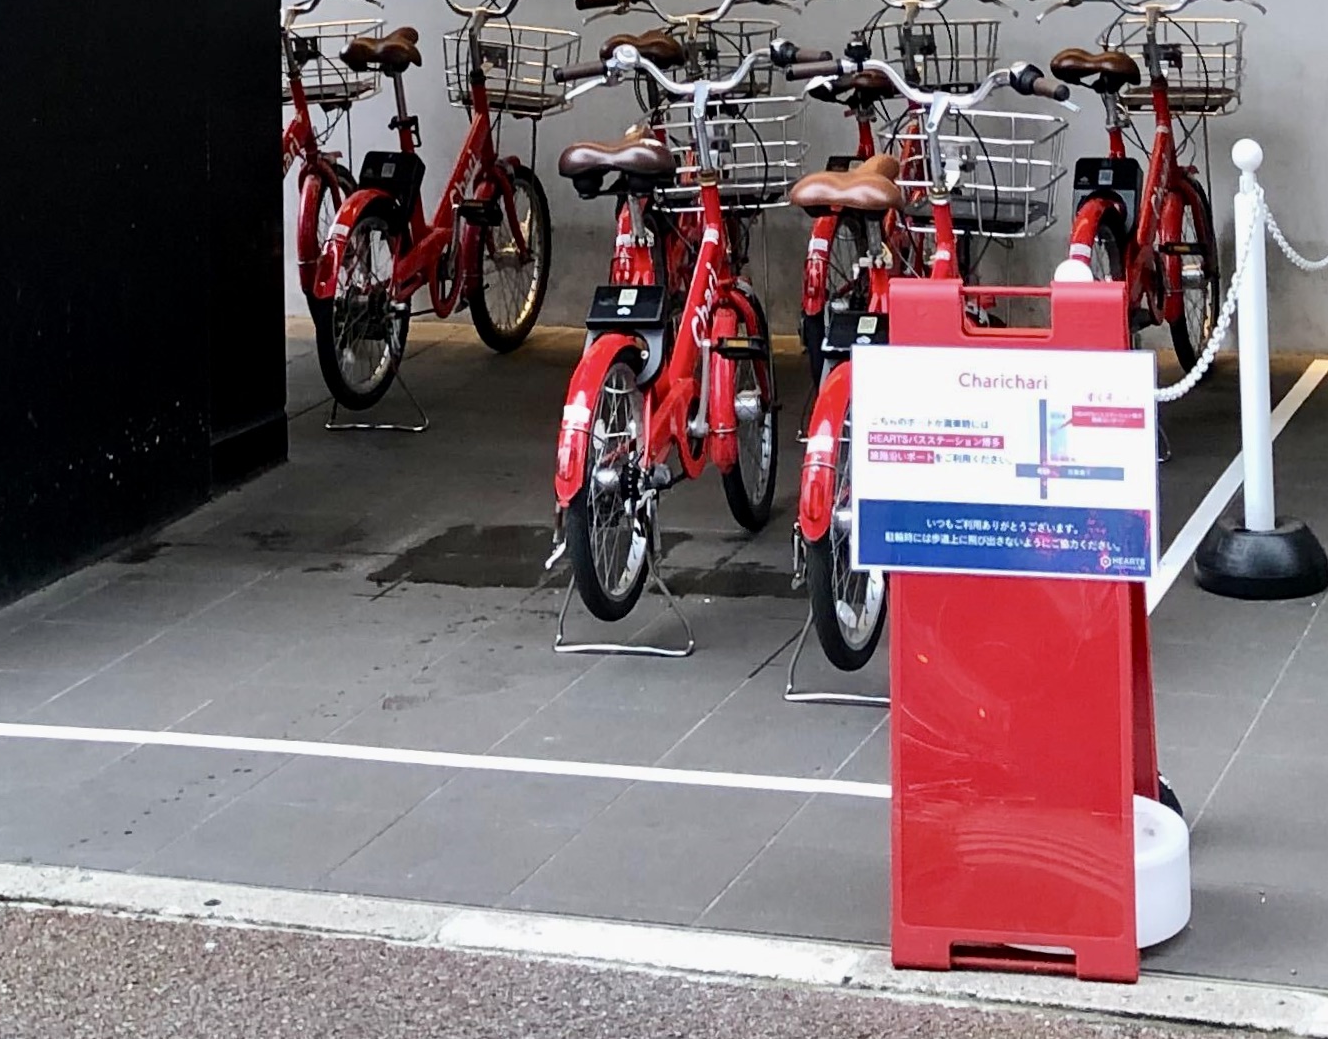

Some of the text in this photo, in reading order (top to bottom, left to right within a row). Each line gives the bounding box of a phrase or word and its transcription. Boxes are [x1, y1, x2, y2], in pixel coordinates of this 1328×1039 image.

[958, 373, 1048, 390] Charichari
[872, 417, 989, 429] こちらのポトが満車時には
[926, 518, 1078, 535] いつもご利用ありがとうございます。
[1112, 557, 1146, 566] HEARTS
